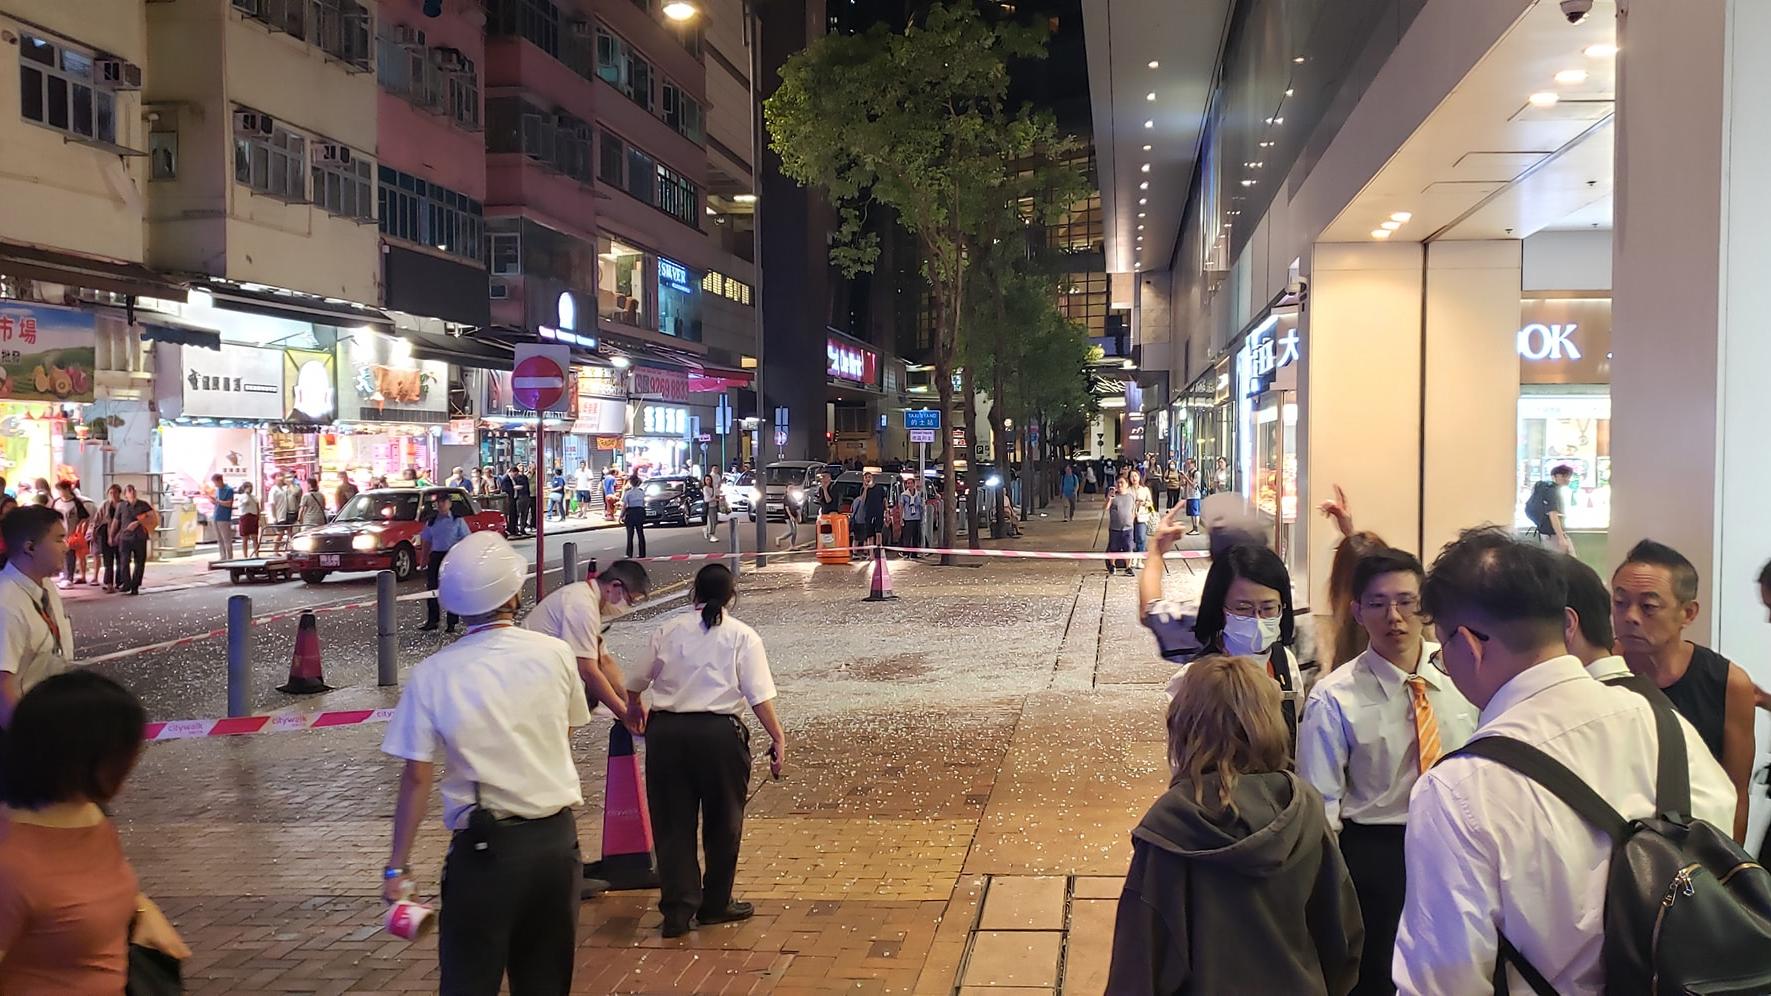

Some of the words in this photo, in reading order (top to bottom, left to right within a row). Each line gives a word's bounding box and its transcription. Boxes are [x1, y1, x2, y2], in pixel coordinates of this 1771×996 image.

[0, 315, 37, 344] 市場
[1517, 323, 1581, 360] OK
[376, 710, 395, 719] city
